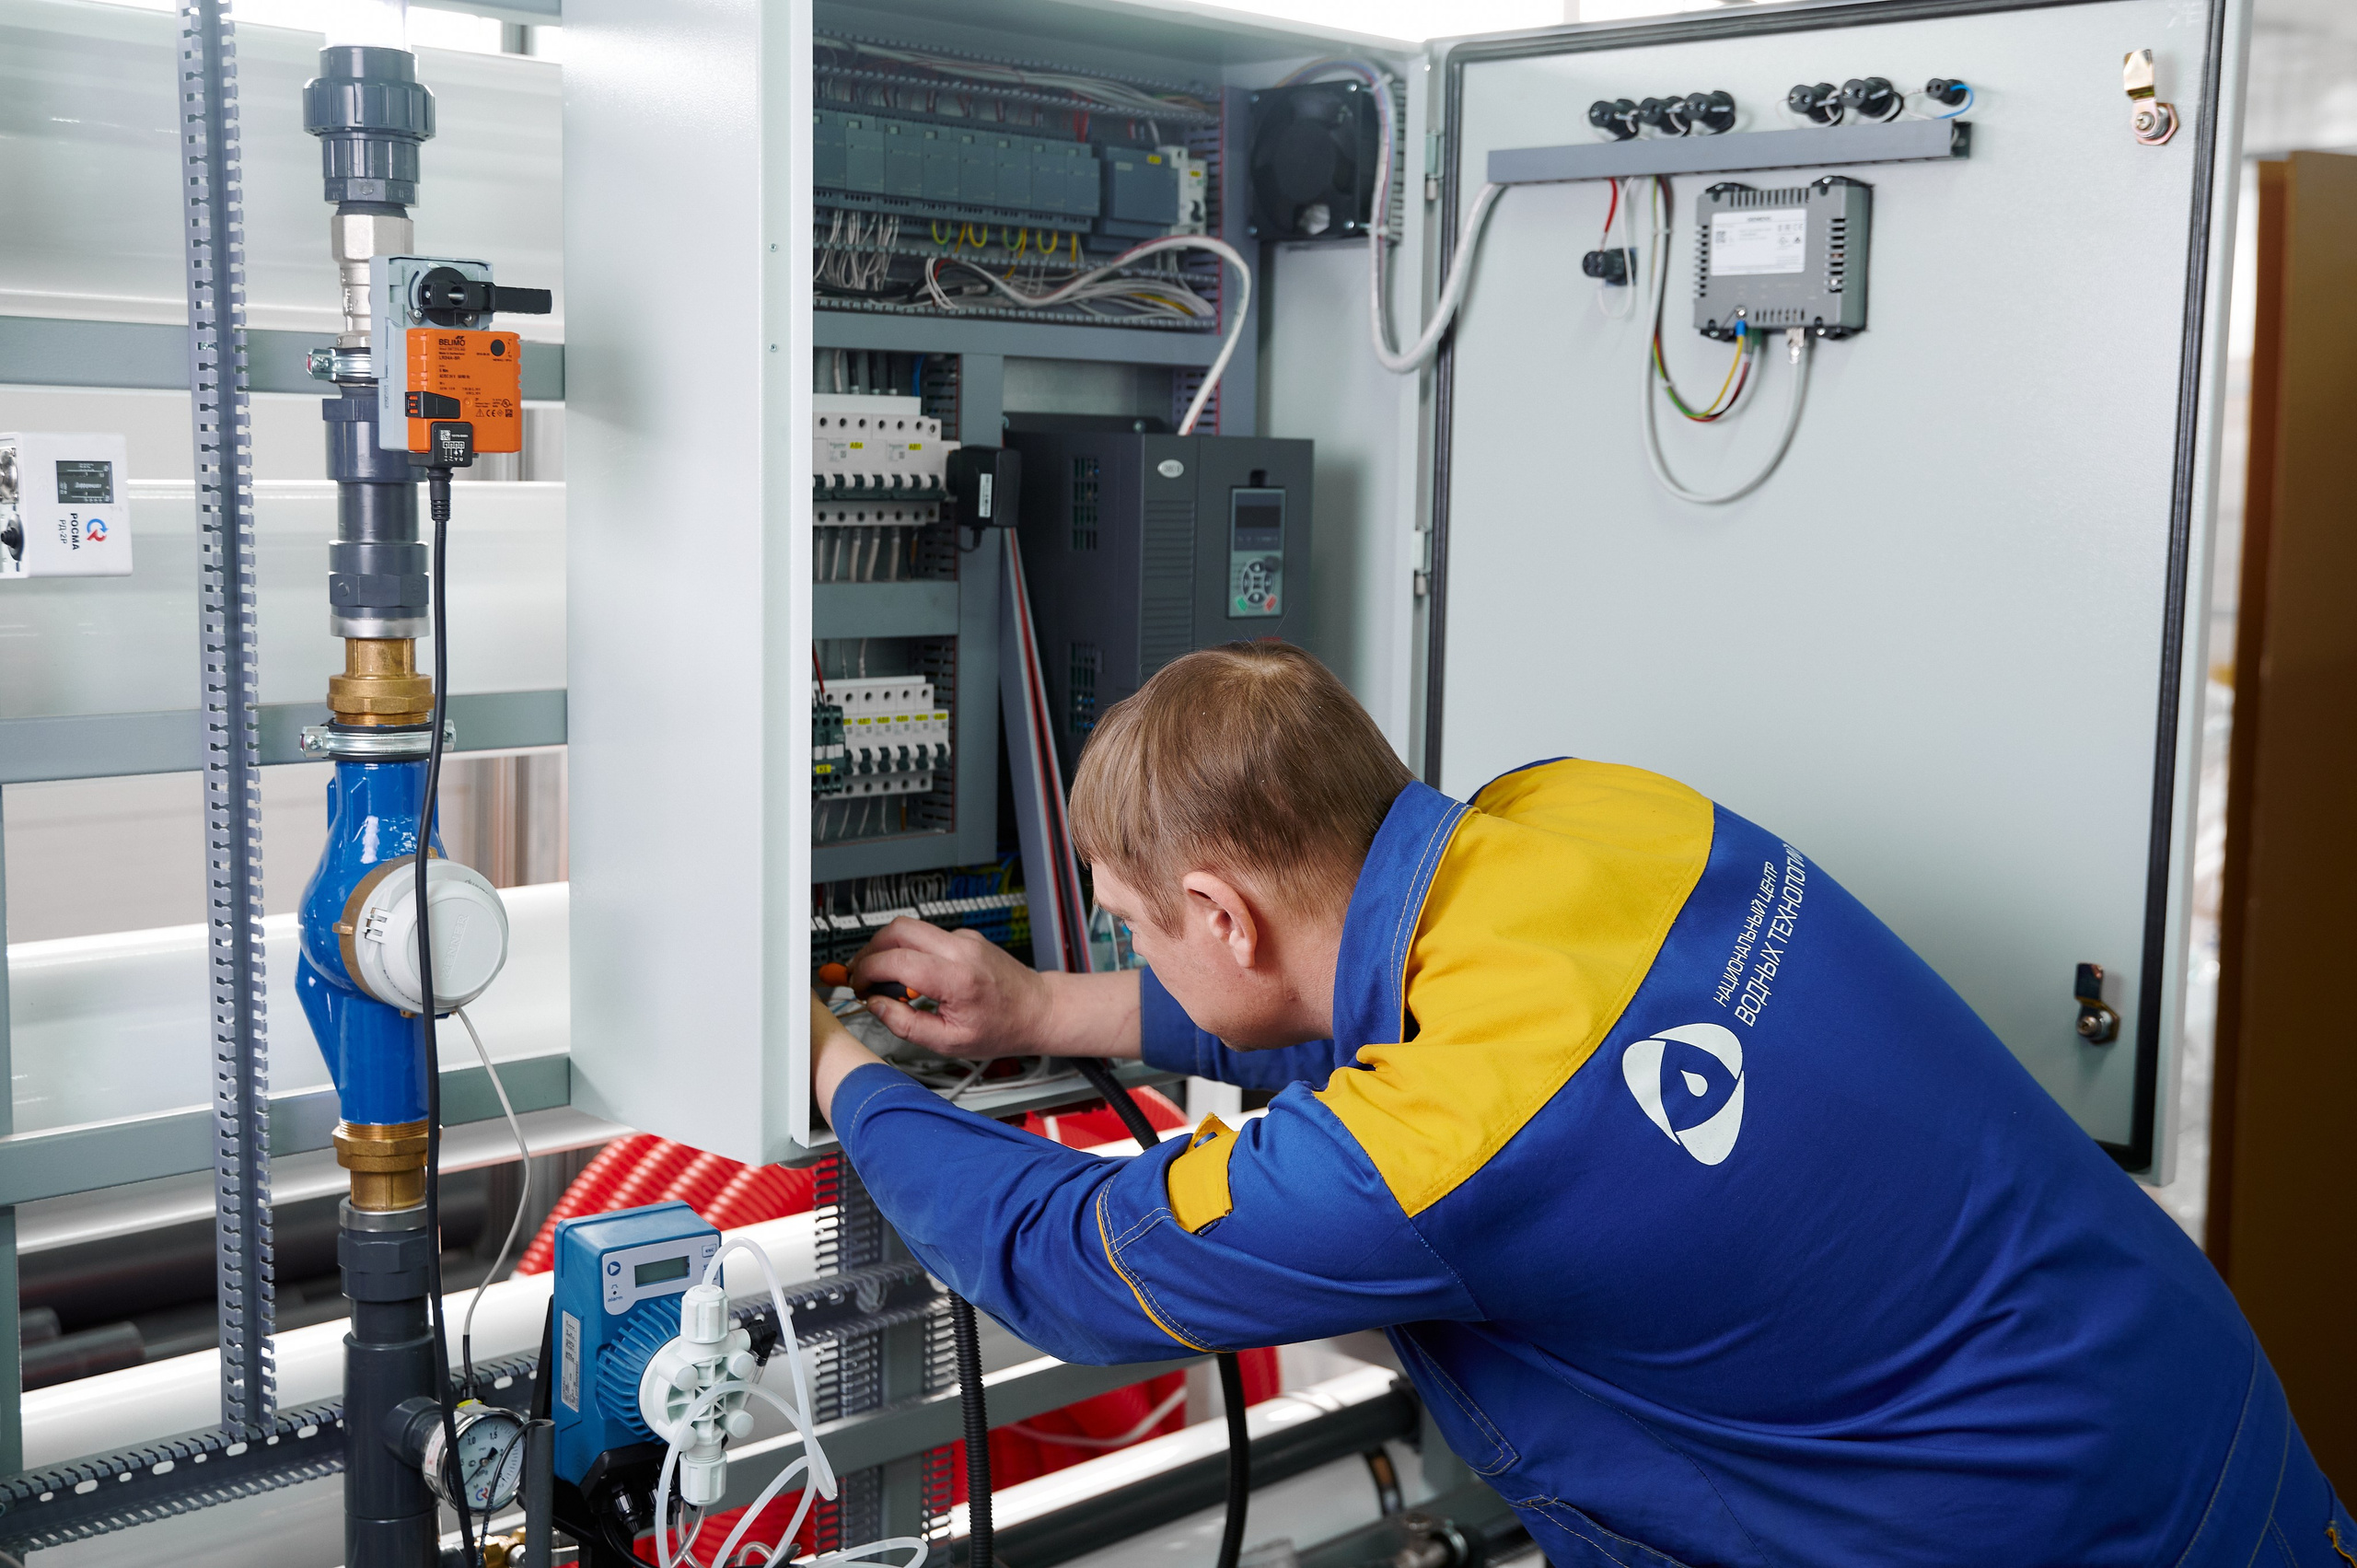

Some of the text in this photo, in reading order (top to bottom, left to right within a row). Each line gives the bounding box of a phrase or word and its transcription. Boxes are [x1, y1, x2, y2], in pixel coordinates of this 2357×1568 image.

[439, 338, 466, 346] BELIMO
[70, 512, 80, 550] РОСМА
[442, 914, 470, 980] ZENNER
[1713, 861, 1778, 1007] НАЦИОНАЛЬНЫЙ ЦЕНТР
[1734, 941, 1784, 1028] ВОДНЫХ
